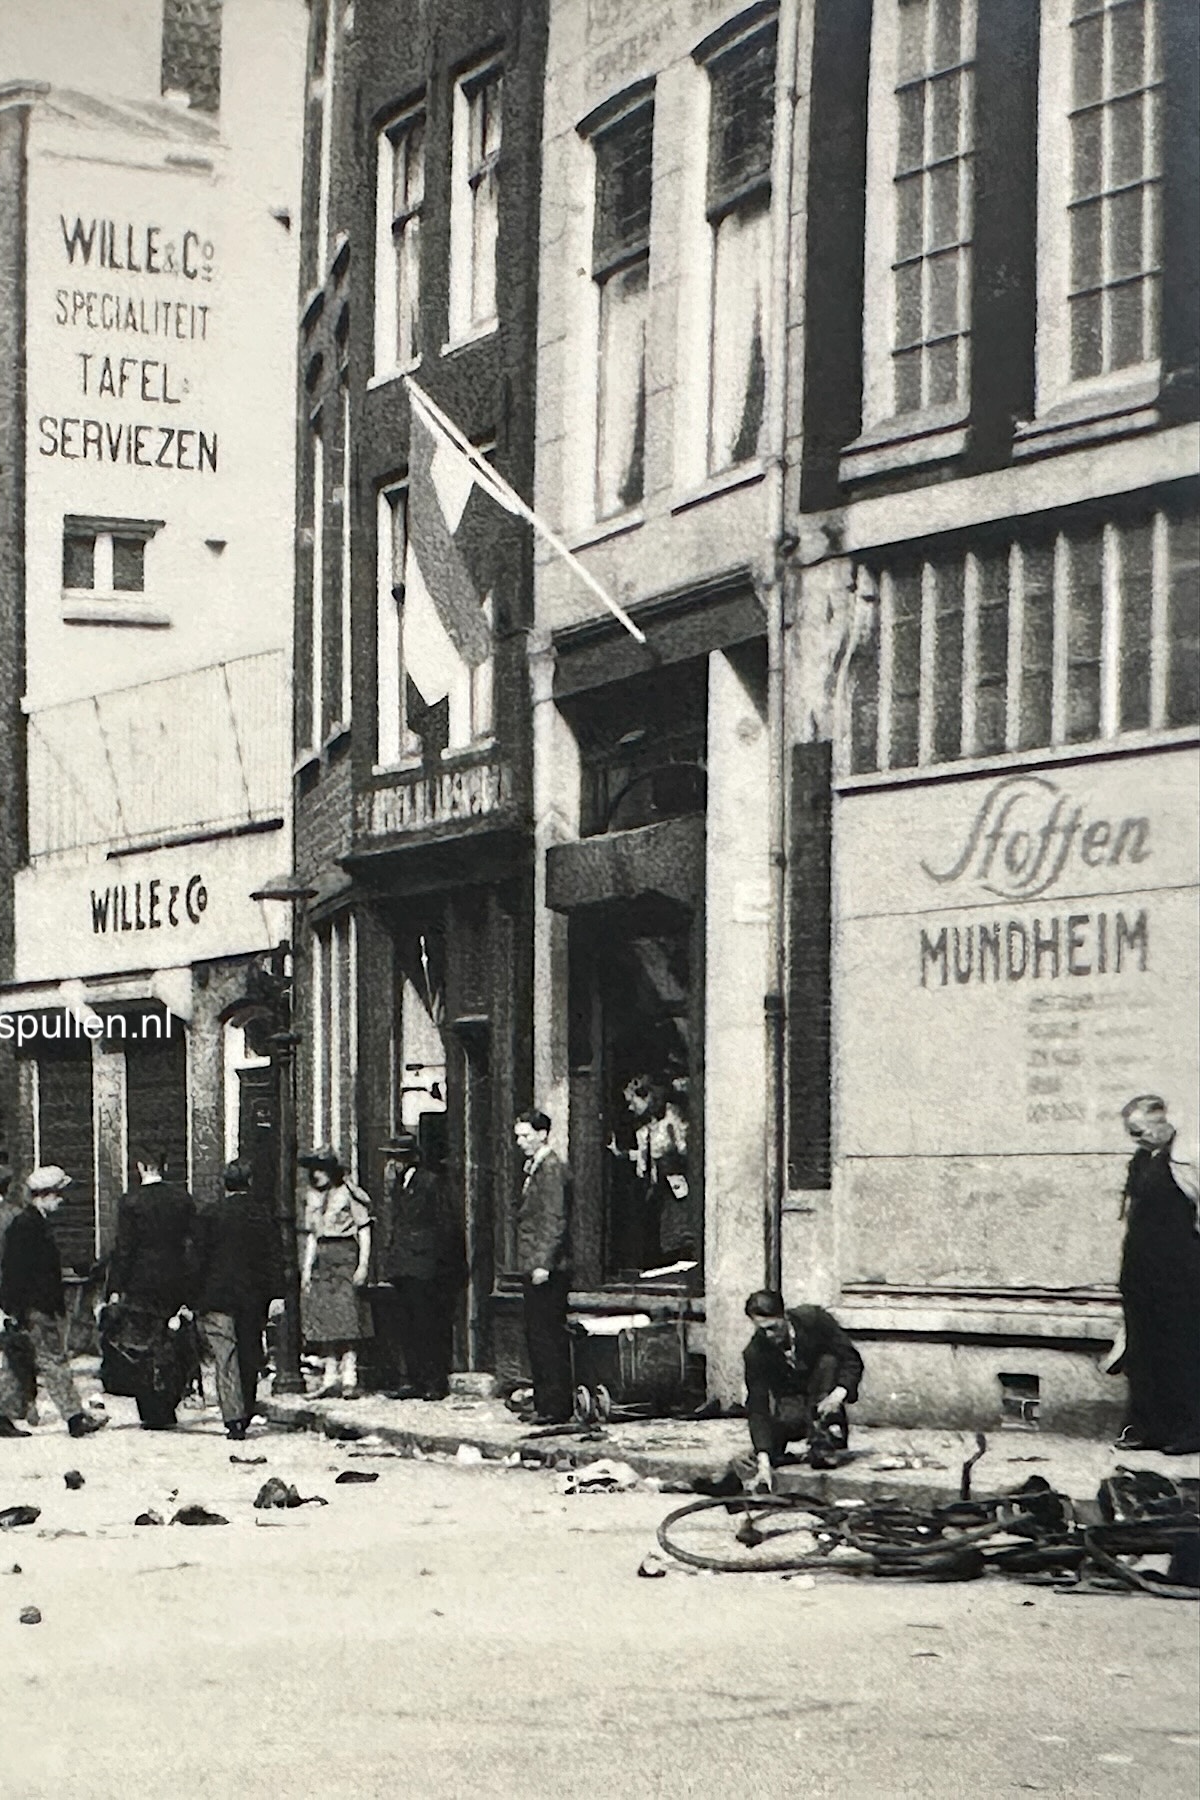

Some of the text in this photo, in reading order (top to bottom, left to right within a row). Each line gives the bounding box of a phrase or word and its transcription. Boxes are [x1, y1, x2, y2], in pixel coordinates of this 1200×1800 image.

[60, 213, 161, 274] WILLE
[56, 288, 209, 341] SPECIALITEIT
[39, 415, 218, 473] SERVIEZEN
[920, 774, 1152, 900] Stoffen
[90, 879, 161, 934] WILLE
[920, 909, 1148, 988] MUNDHEIM
